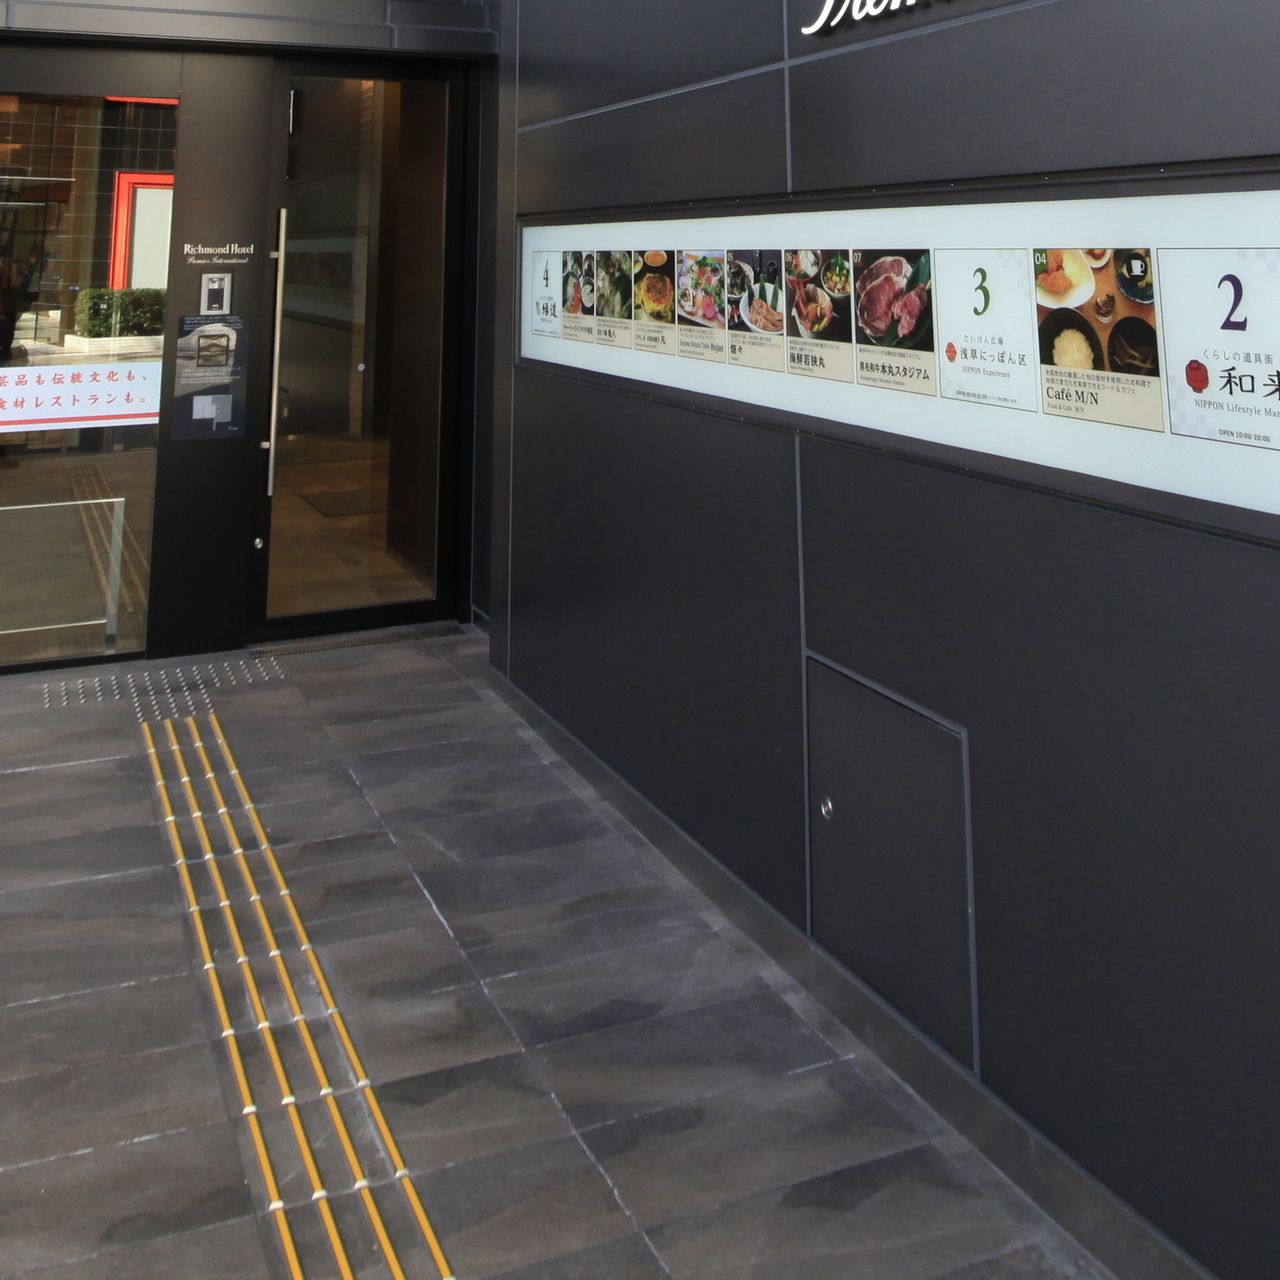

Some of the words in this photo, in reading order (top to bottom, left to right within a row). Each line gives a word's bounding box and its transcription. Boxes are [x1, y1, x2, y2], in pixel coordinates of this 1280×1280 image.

[183, 243, 230, 255] Richmond
[231, 243, 254, 254] Hotel
[1034, 252, 1047, 265] 04
[543, 259, 550, 287] 4
[972, 267, 991, 316] 3
[1217, 273, 1248, 332] 2
[1202, 349, 1273, 366] くらしの道具街
[1046, 386, 1073, 402] Café
[1075, 390, 1099, 406] M/N
[1194, 398, 1225, 411] NIPPON
[1226, 403, 1262, 417] Lifestyle
[1218, 428, 1235, 438] OPEN
